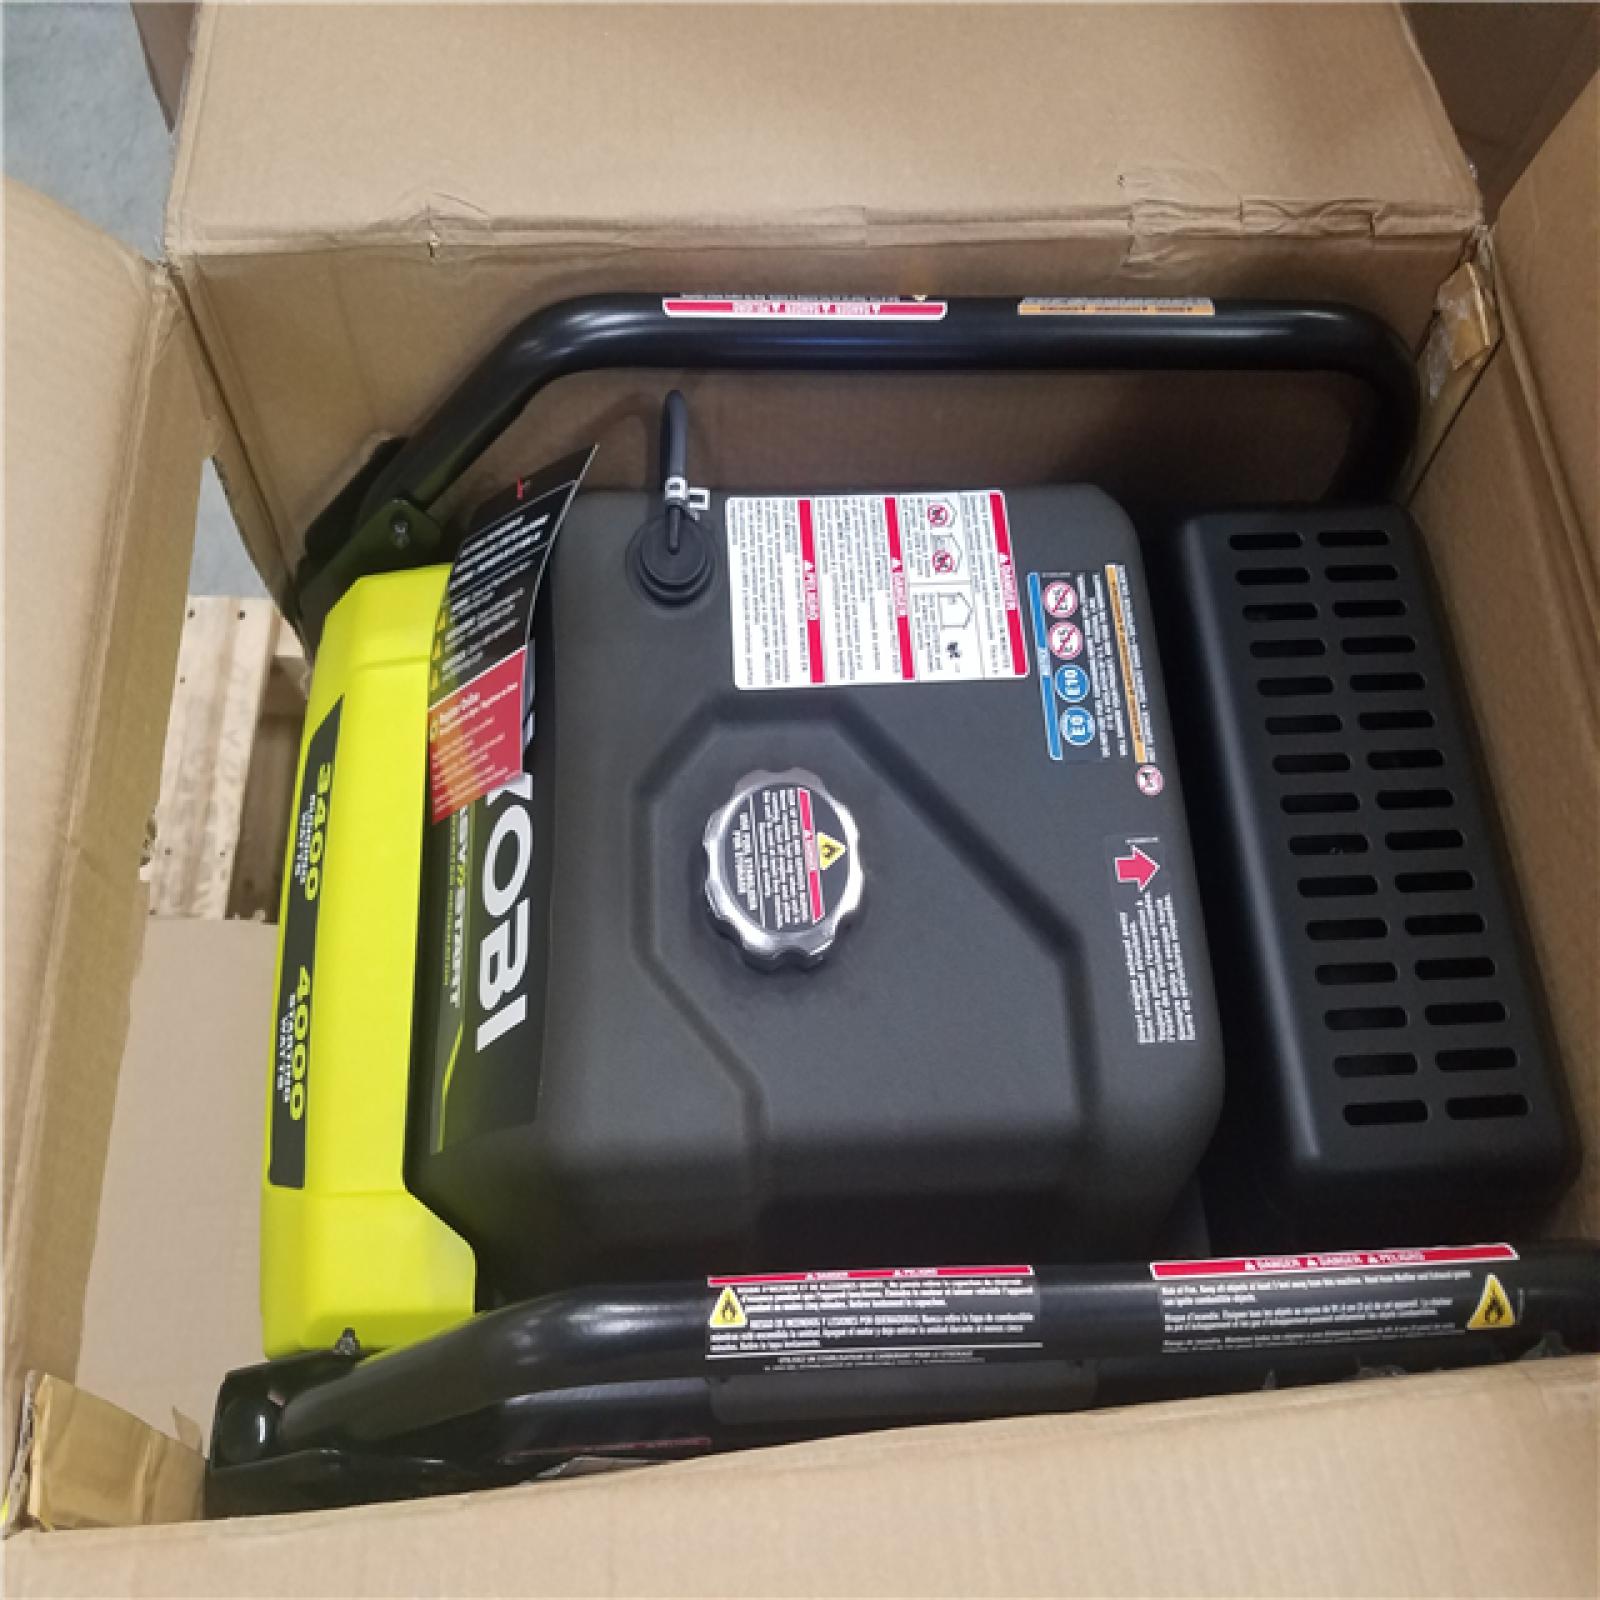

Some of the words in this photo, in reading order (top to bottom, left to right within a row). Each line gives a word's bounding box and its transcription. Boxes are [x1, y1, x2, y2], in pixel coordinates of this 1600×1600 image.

[804, 572, 818, 619] PELIGRO
[892, 573, 907, 616] DANGER
[1000, 565, 1016, 610] DANGER
[1064, 670, 1080, 695] E10
[1070, 714, 1085, 736] E0
[294, 812, 306, 877] WATTS
[299, 794, 316, 885] RUNNING
[304, 763, 331, 901] 3400
[277, 1016, 287, 1090] WATTS
[284, 994, 296, 1102] STARTING
[290, 966, 310, 1120] 4000
[1258, 1259, 1300, 1270] DANGER
[1320, 1255, 1362, 1266] DANGER
[1379, 1252, 1425, 1263] PELIGRO
